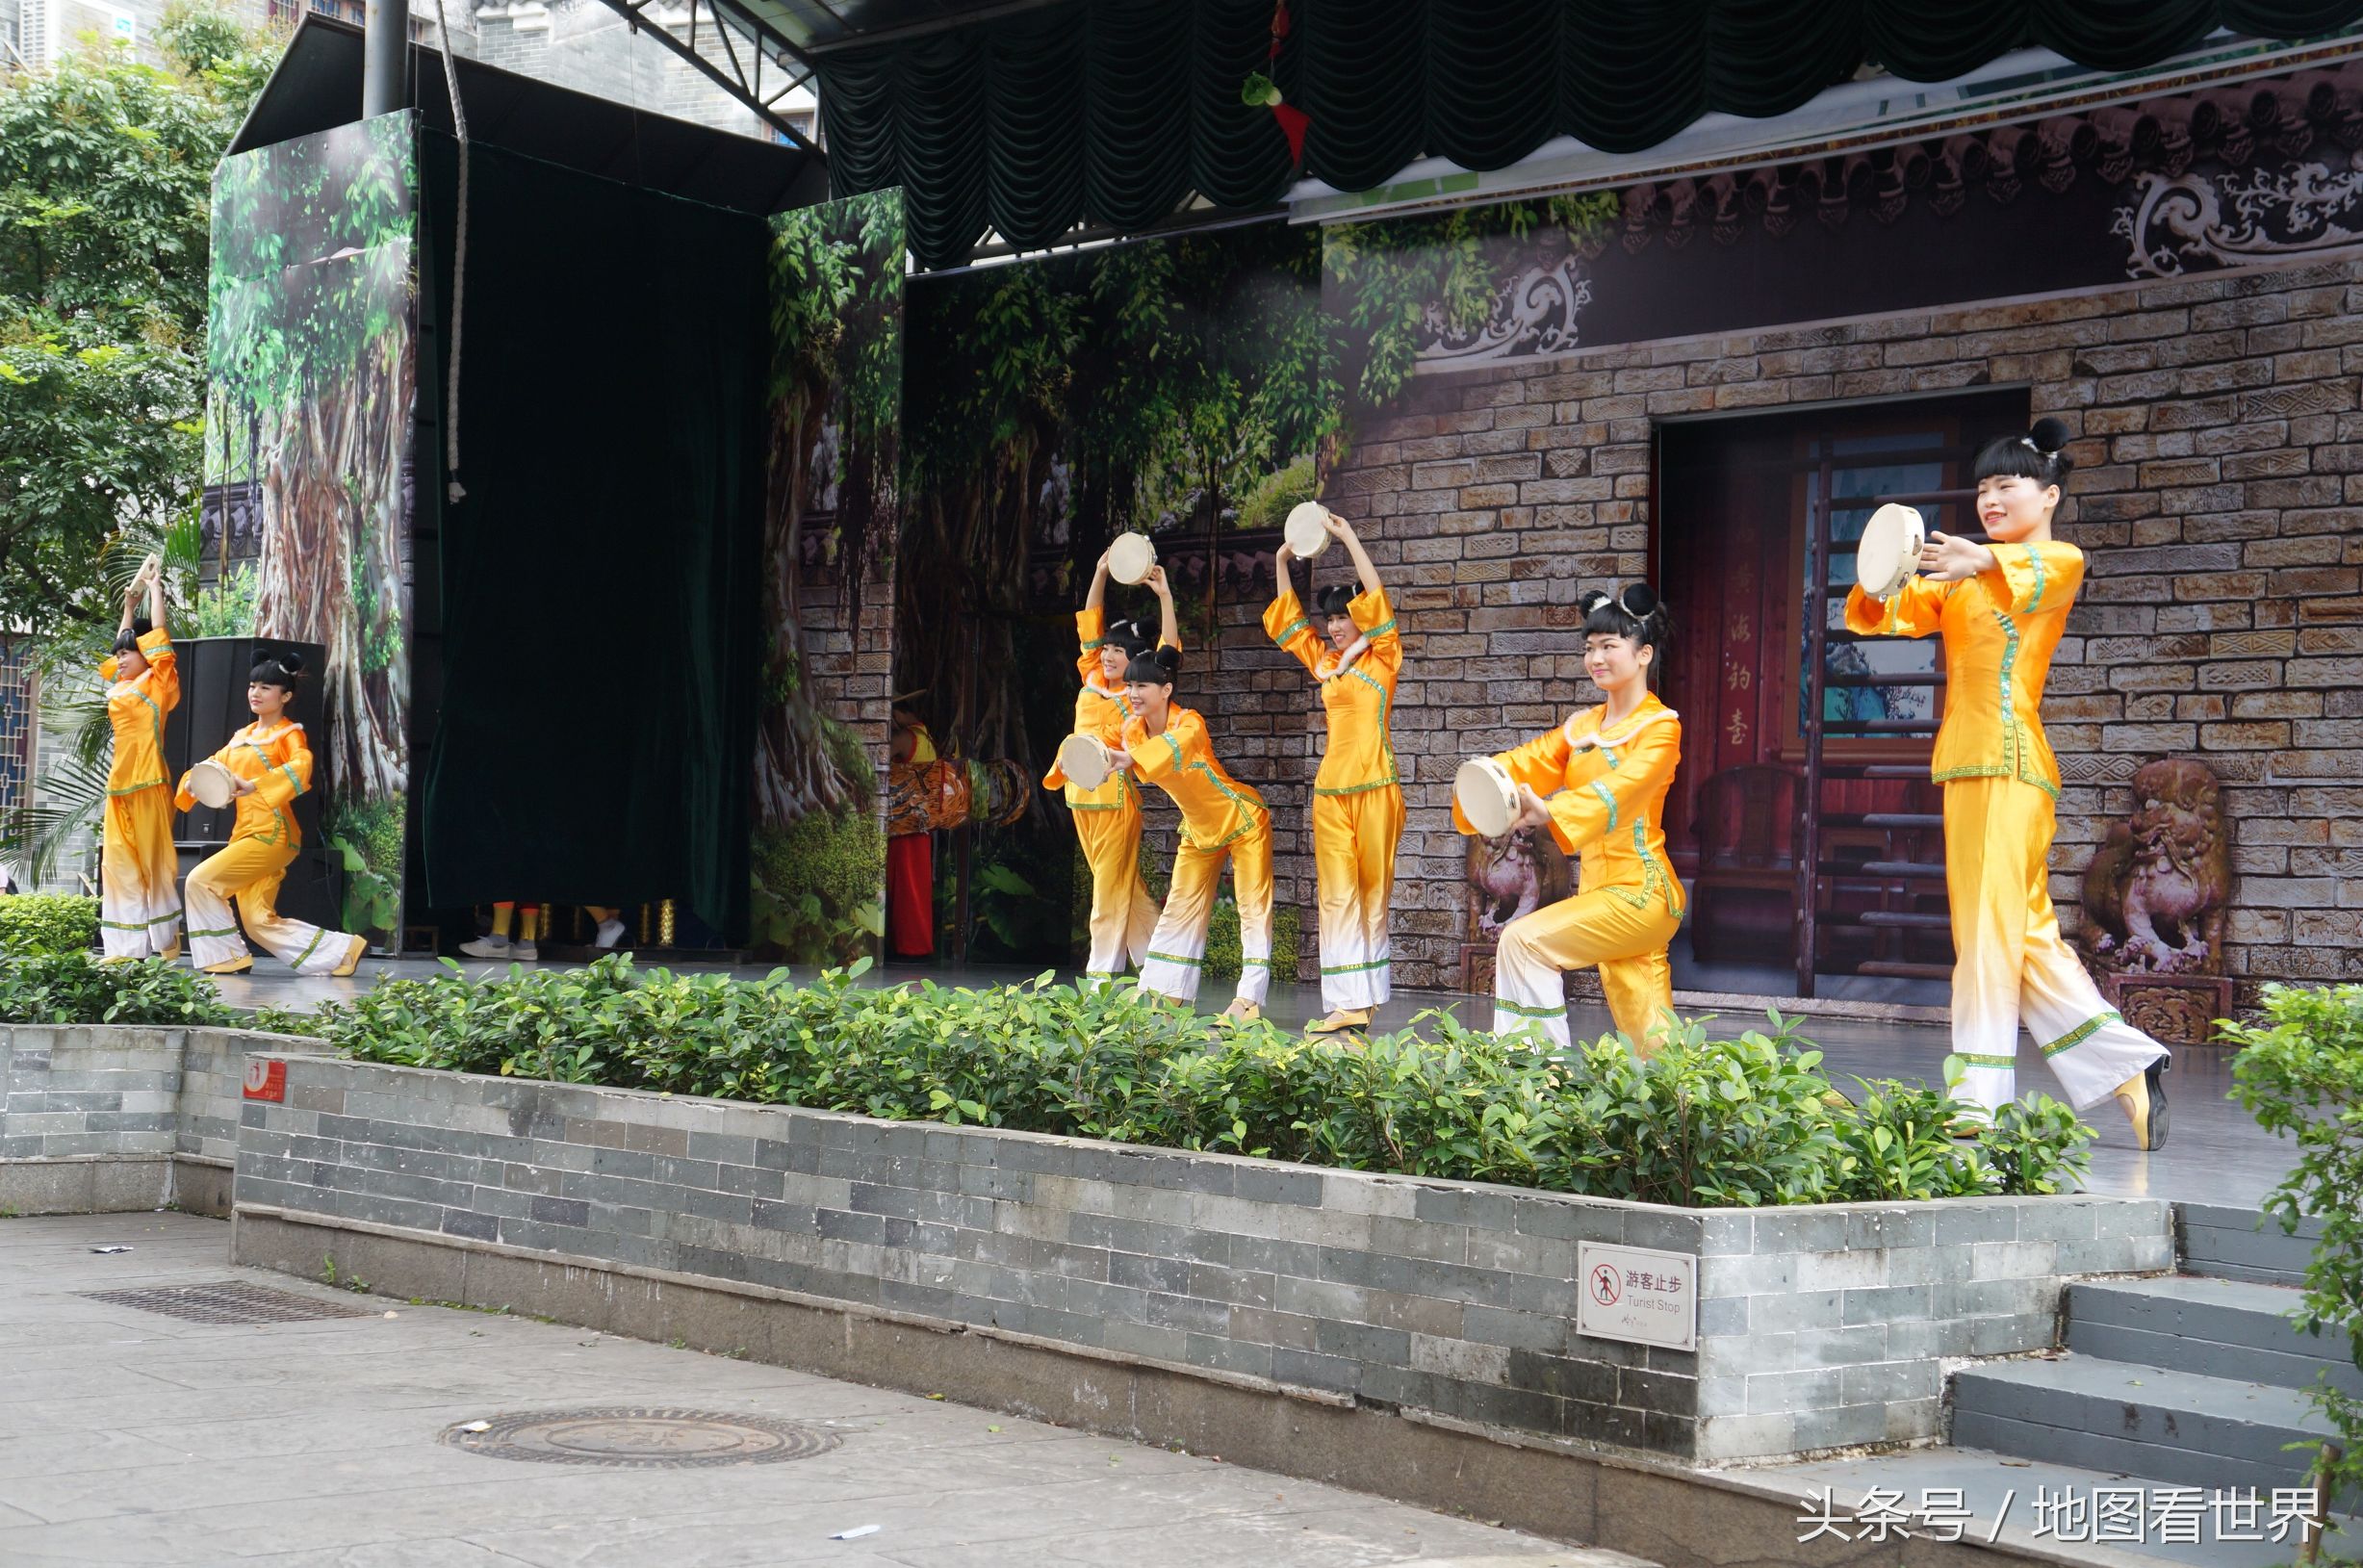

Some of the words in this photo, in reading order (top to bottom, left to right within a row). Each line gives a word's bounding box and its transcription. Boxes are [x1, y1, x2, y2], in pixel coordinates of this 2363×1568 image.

[1626, 1270, 1682, 1294] 游客止步
[1627, 1295, 1657, 1310] Turist
[1657, 1299, 1681, 1315] Stop
